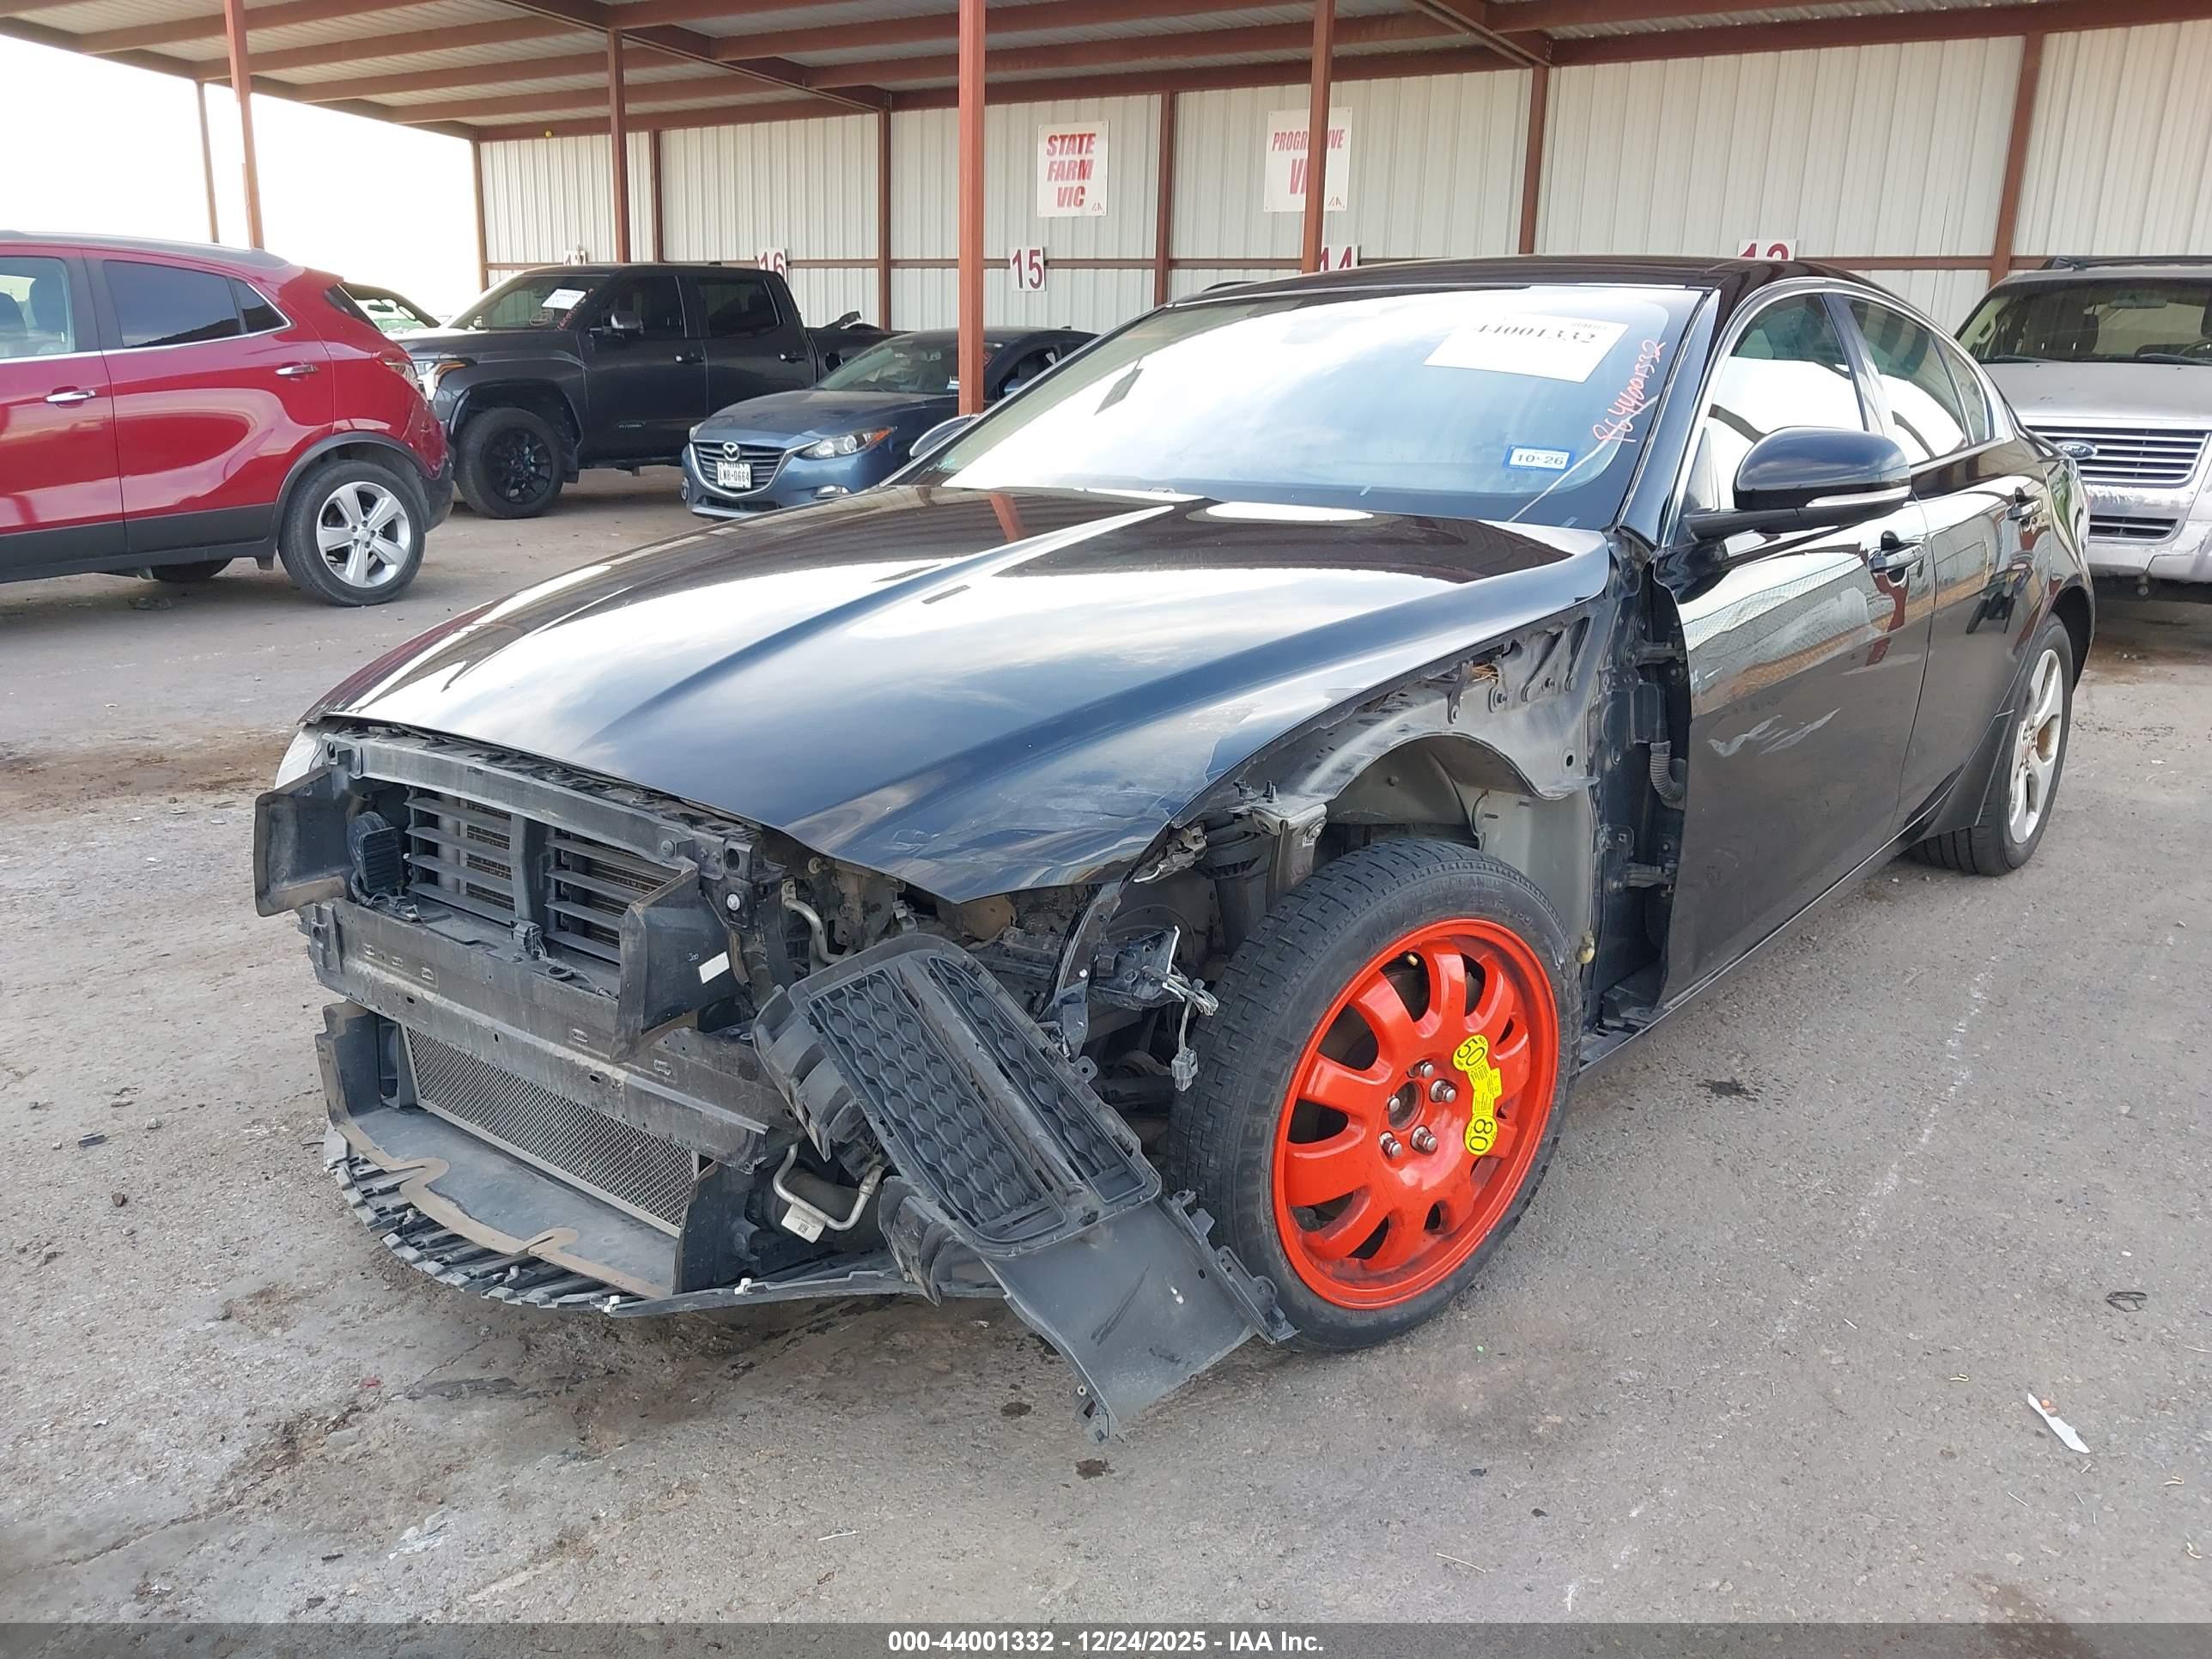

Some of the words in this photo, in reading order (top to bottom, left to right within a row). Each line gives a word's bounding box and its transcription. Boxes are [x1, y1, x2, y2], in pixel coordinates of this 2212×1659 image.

[1046, 133, 1096, 156] STATE
[1272, 129, 1346, 151] PROGRIVE
[1047, 159, 1094, 182] FARM
[1290, 158, 1308, 195] VI
[1057, 185, 1085, 208] VIC
[1012, 249, 1042, 289] 15
[1457, 1038, 1486, 1066] 50
[1469, 1119, 1493, 1152] 80
